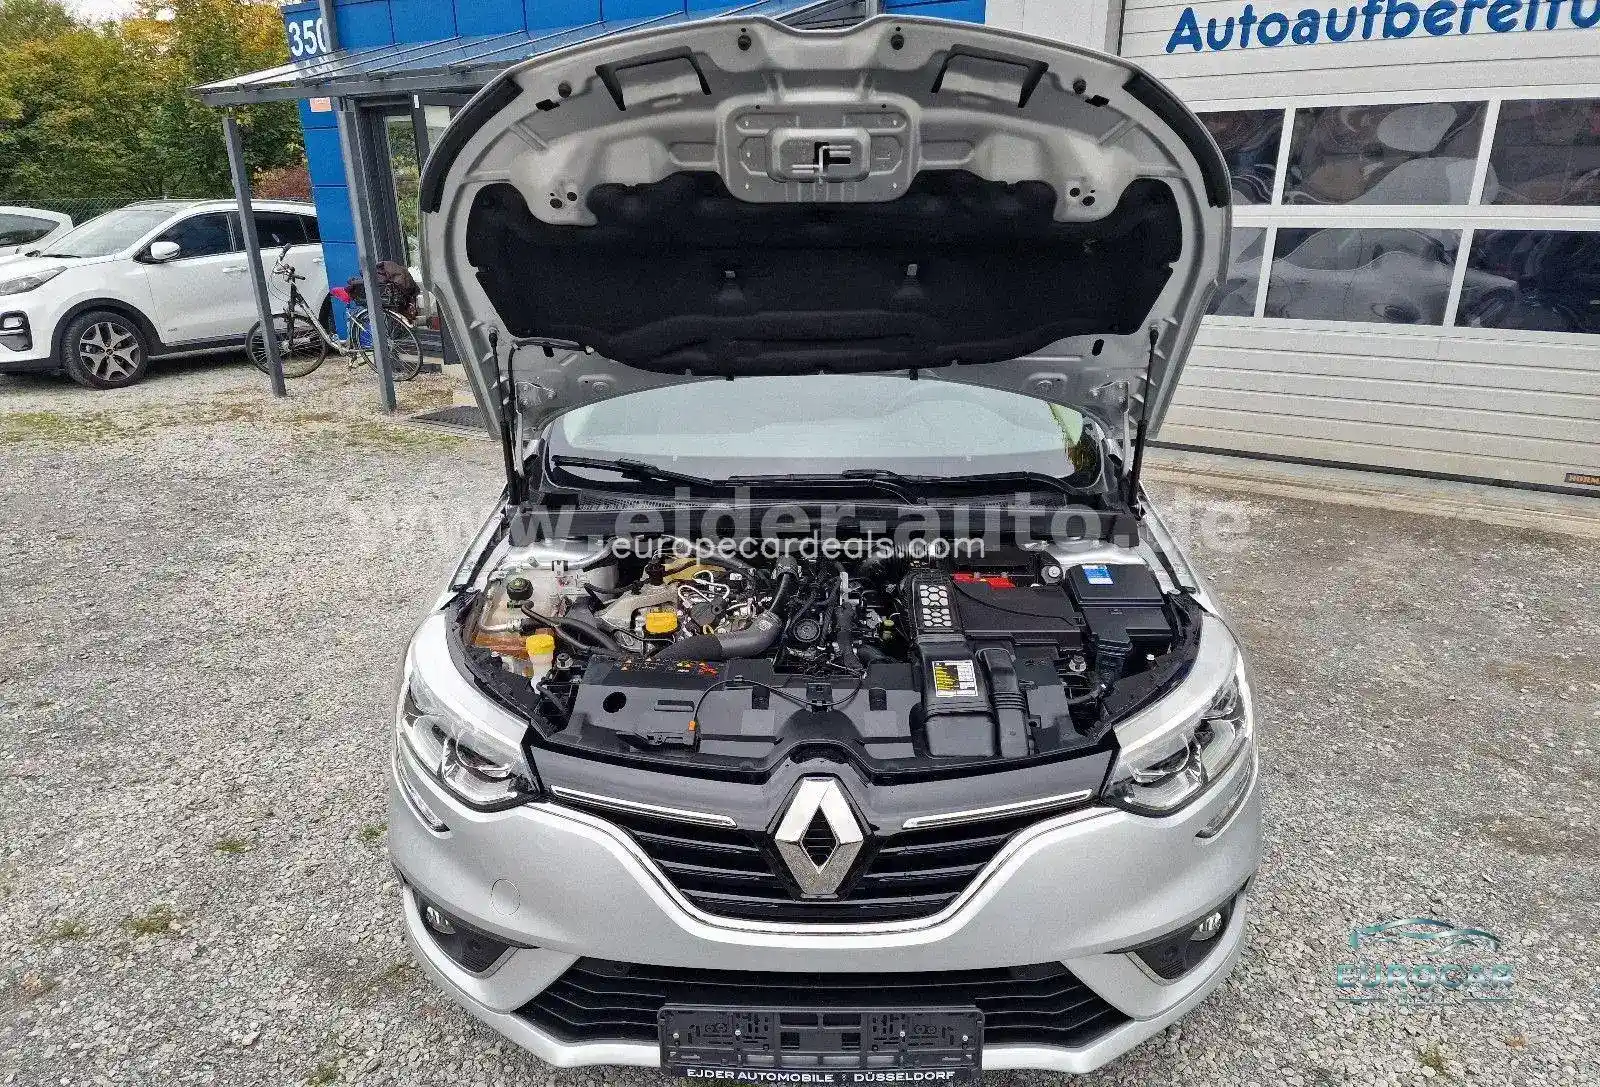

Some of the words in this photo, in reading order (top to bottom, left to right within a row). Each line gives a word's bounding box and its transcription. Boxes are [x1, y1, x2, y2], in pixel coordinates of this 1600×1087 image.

[686, 1068, 735, 1081] EJDER
[737, 1071, 835, 1083] AUTOMOBILE
[853, 1070, 956, 1083] DÜSSELDORF
